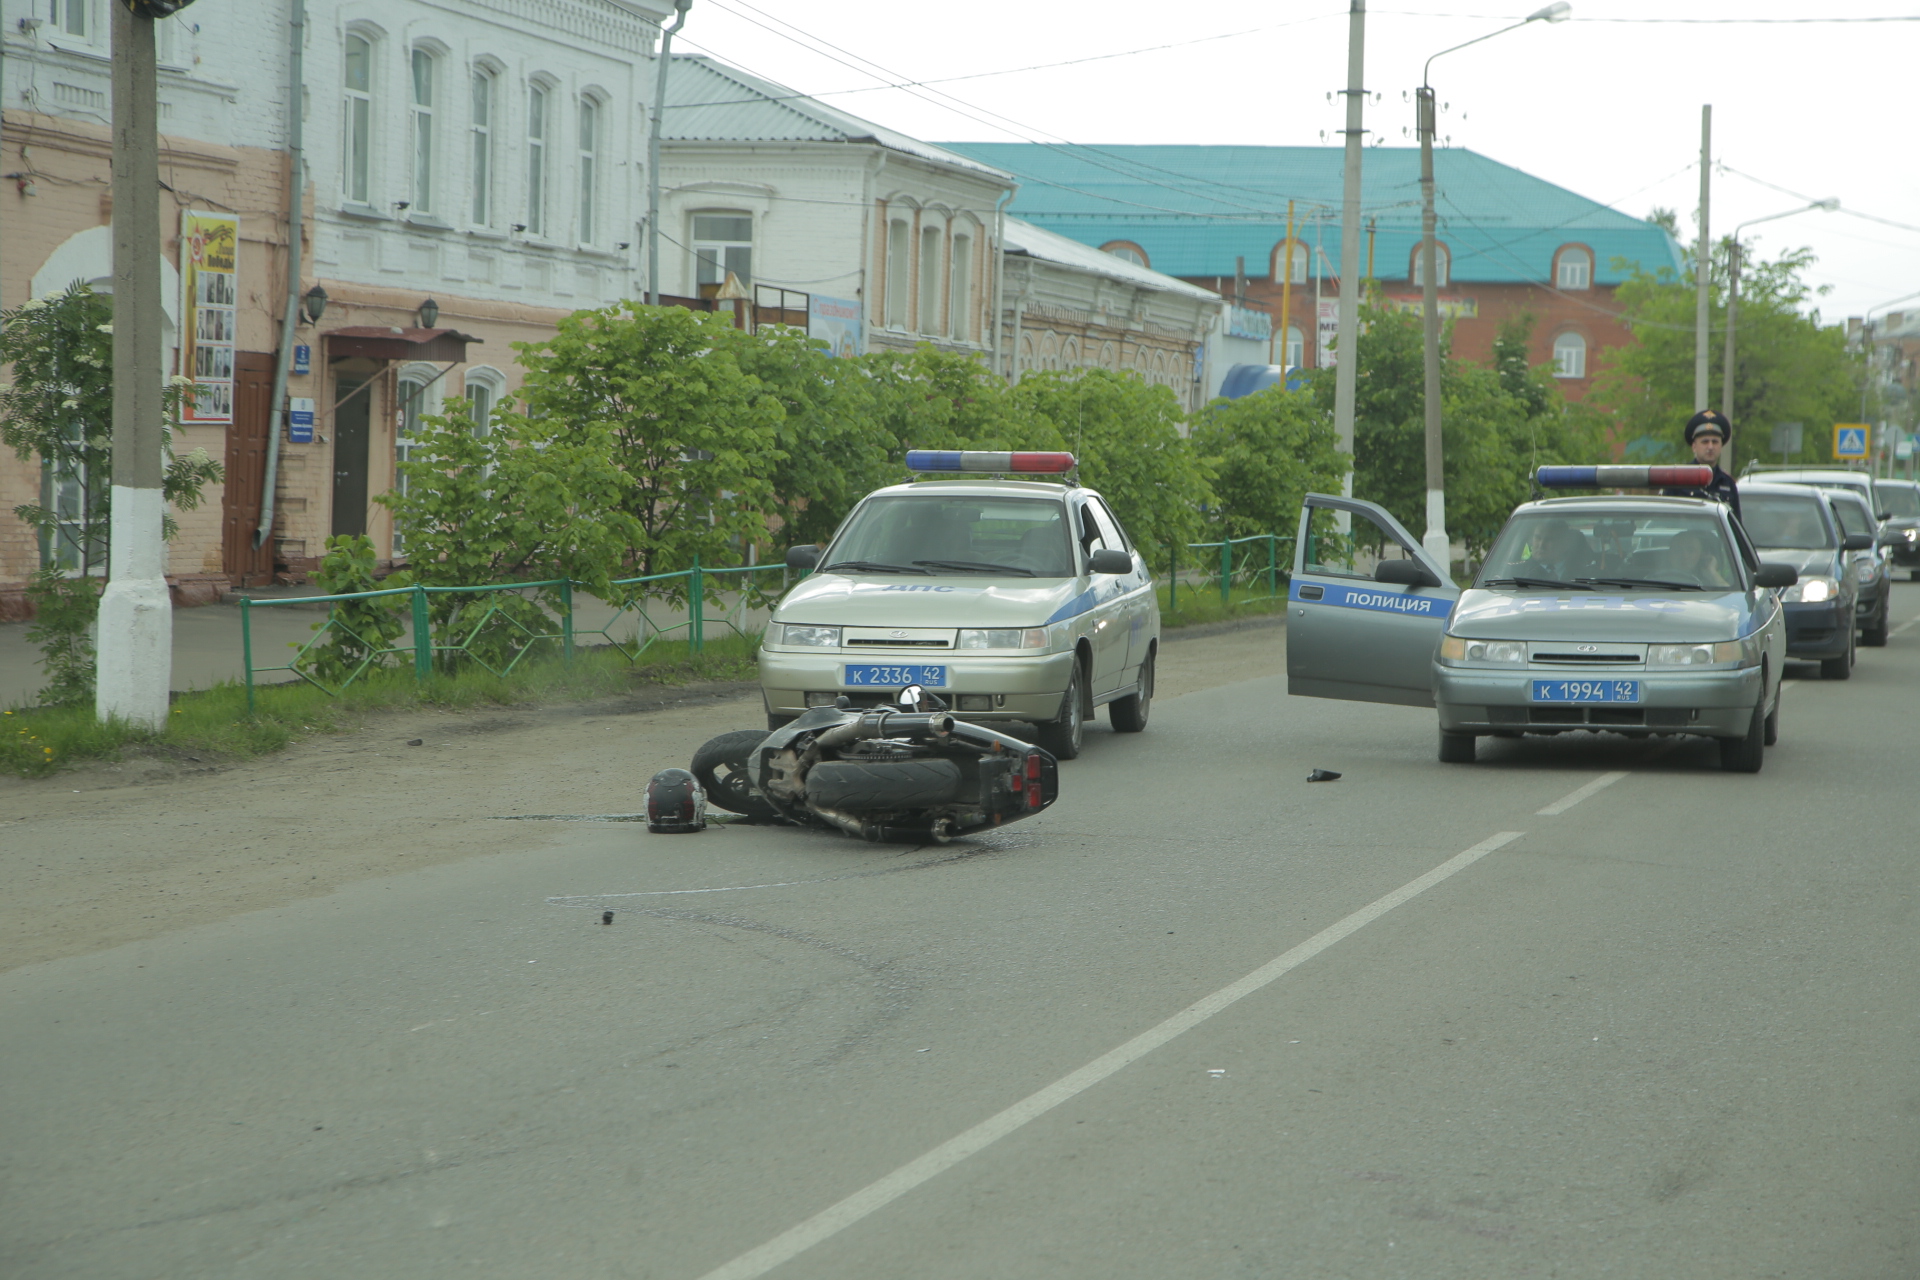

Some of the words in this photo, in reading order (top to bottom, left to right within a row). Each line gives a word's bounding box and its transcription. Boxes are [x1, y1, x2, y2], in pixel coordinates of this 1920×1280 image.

[1345, 592, 1431, 612] ПОЛИЦИЯ
[870, 667, 912, 684] 2336
[923, 667, 940, 680] 42
[1560, 682, 1603, 699] 1994
[1615, 682, 1632, 695] 42
